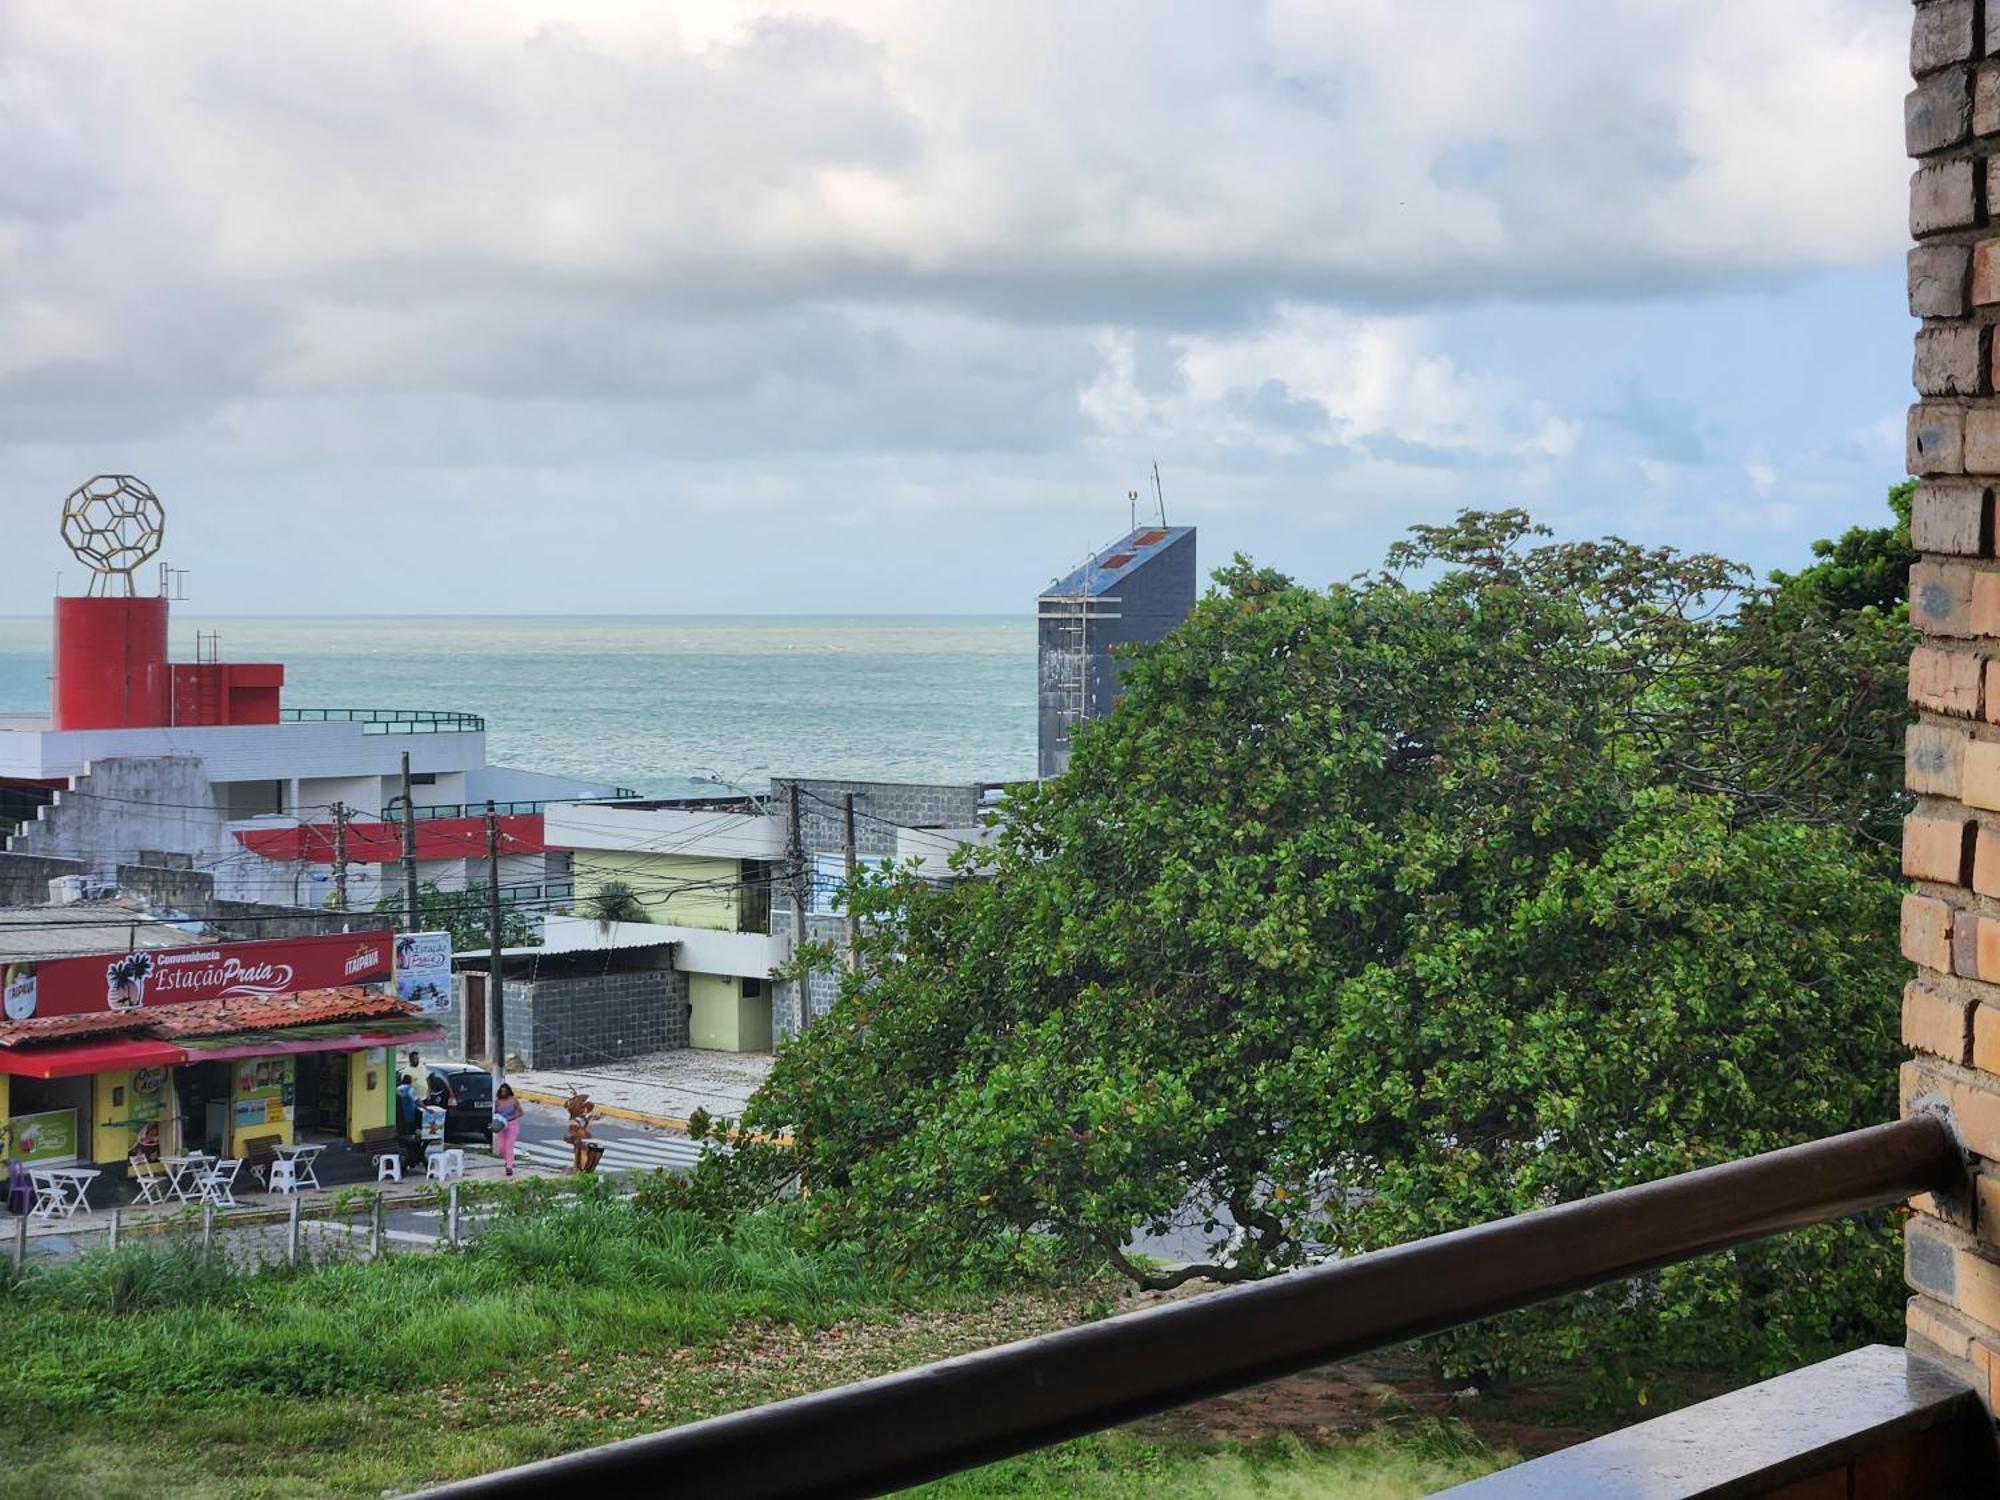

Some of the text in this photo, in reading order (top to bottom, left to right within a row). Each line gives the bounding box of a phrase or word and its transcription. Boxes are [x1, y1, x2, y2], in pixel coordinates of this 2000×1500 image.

[155, 958, 274, 991] Estação Praia
[345, 950, 379, 977] ITAIPAVA
